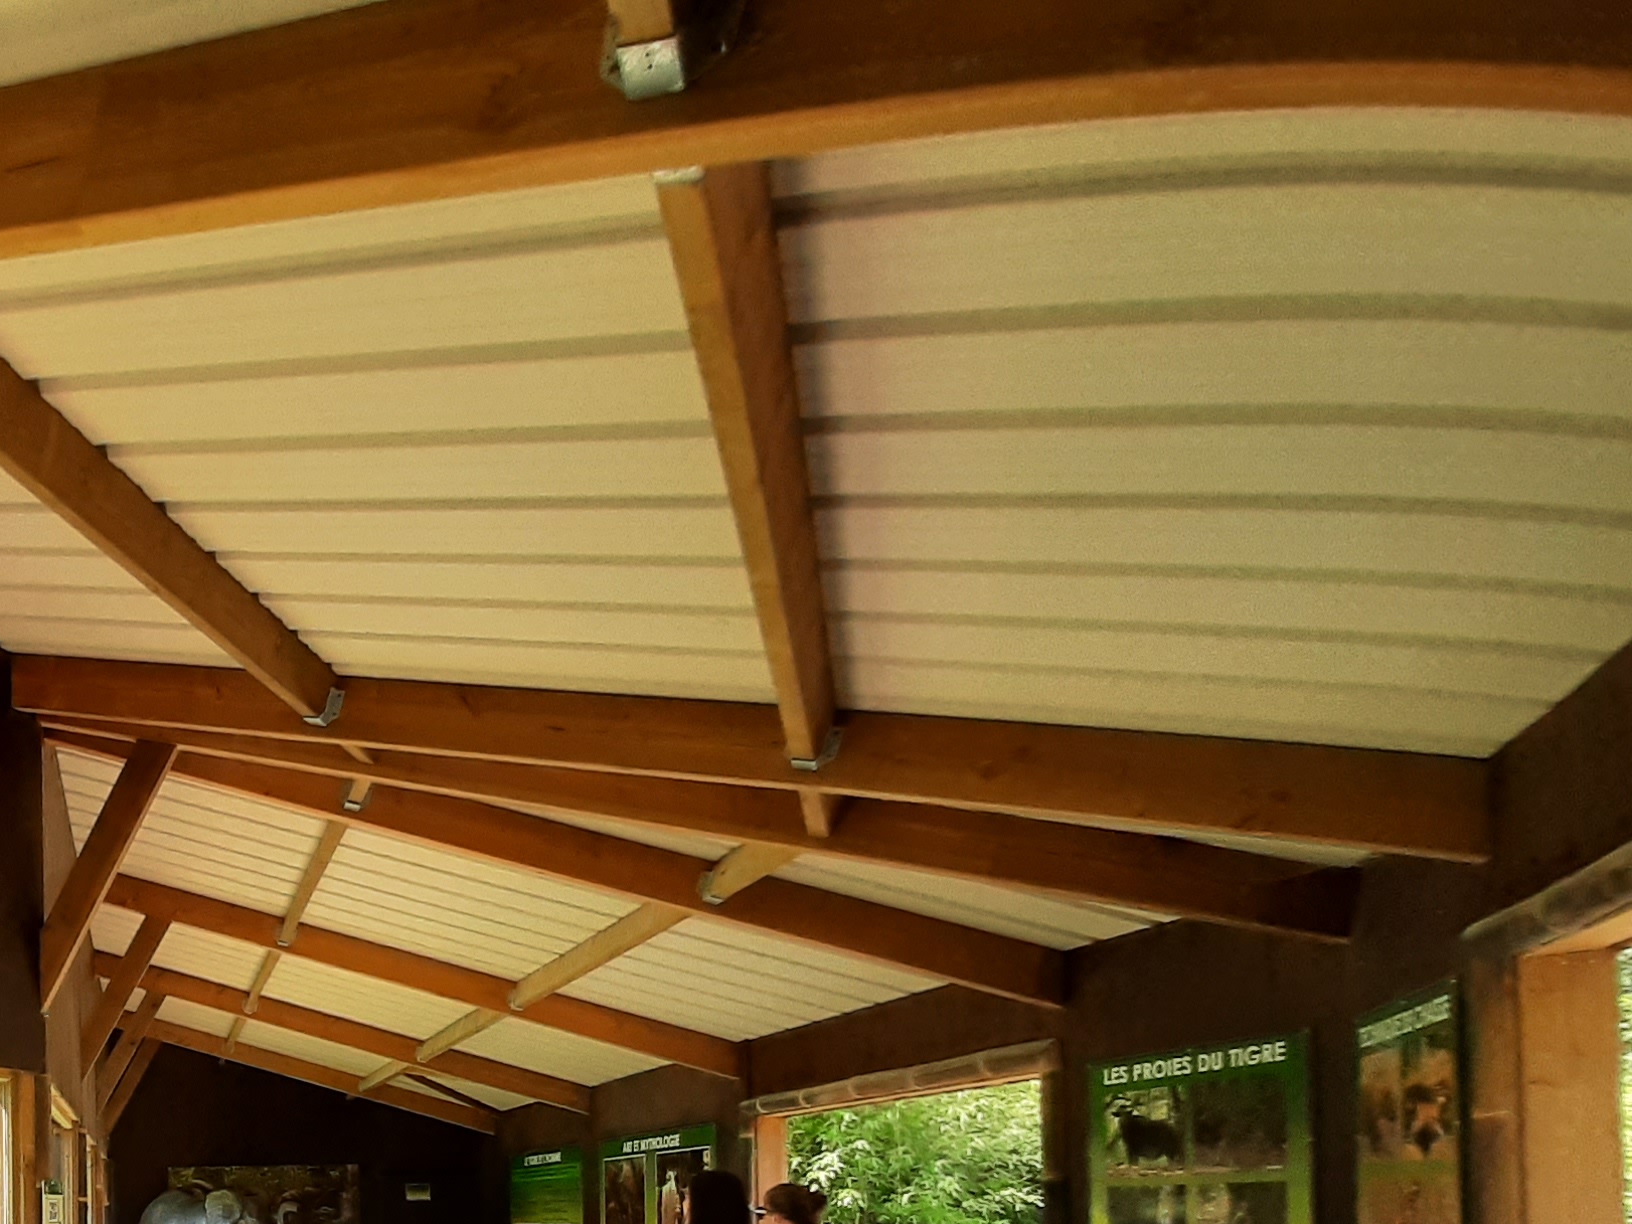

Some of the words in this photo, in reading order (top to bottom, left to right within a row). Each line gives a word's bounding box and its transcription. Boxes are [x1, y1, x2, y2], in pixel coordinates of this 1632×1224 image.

[1103, 1065, 1128, 1086] LES
[1133, 1055, 1193, 1082] PROIES
[1197, 1051, 1224, 1073] DU
[1228, 1040, 1287, 1068] TIGRE
[639, 1133, 680, 1151] MYTHOLOGIE
